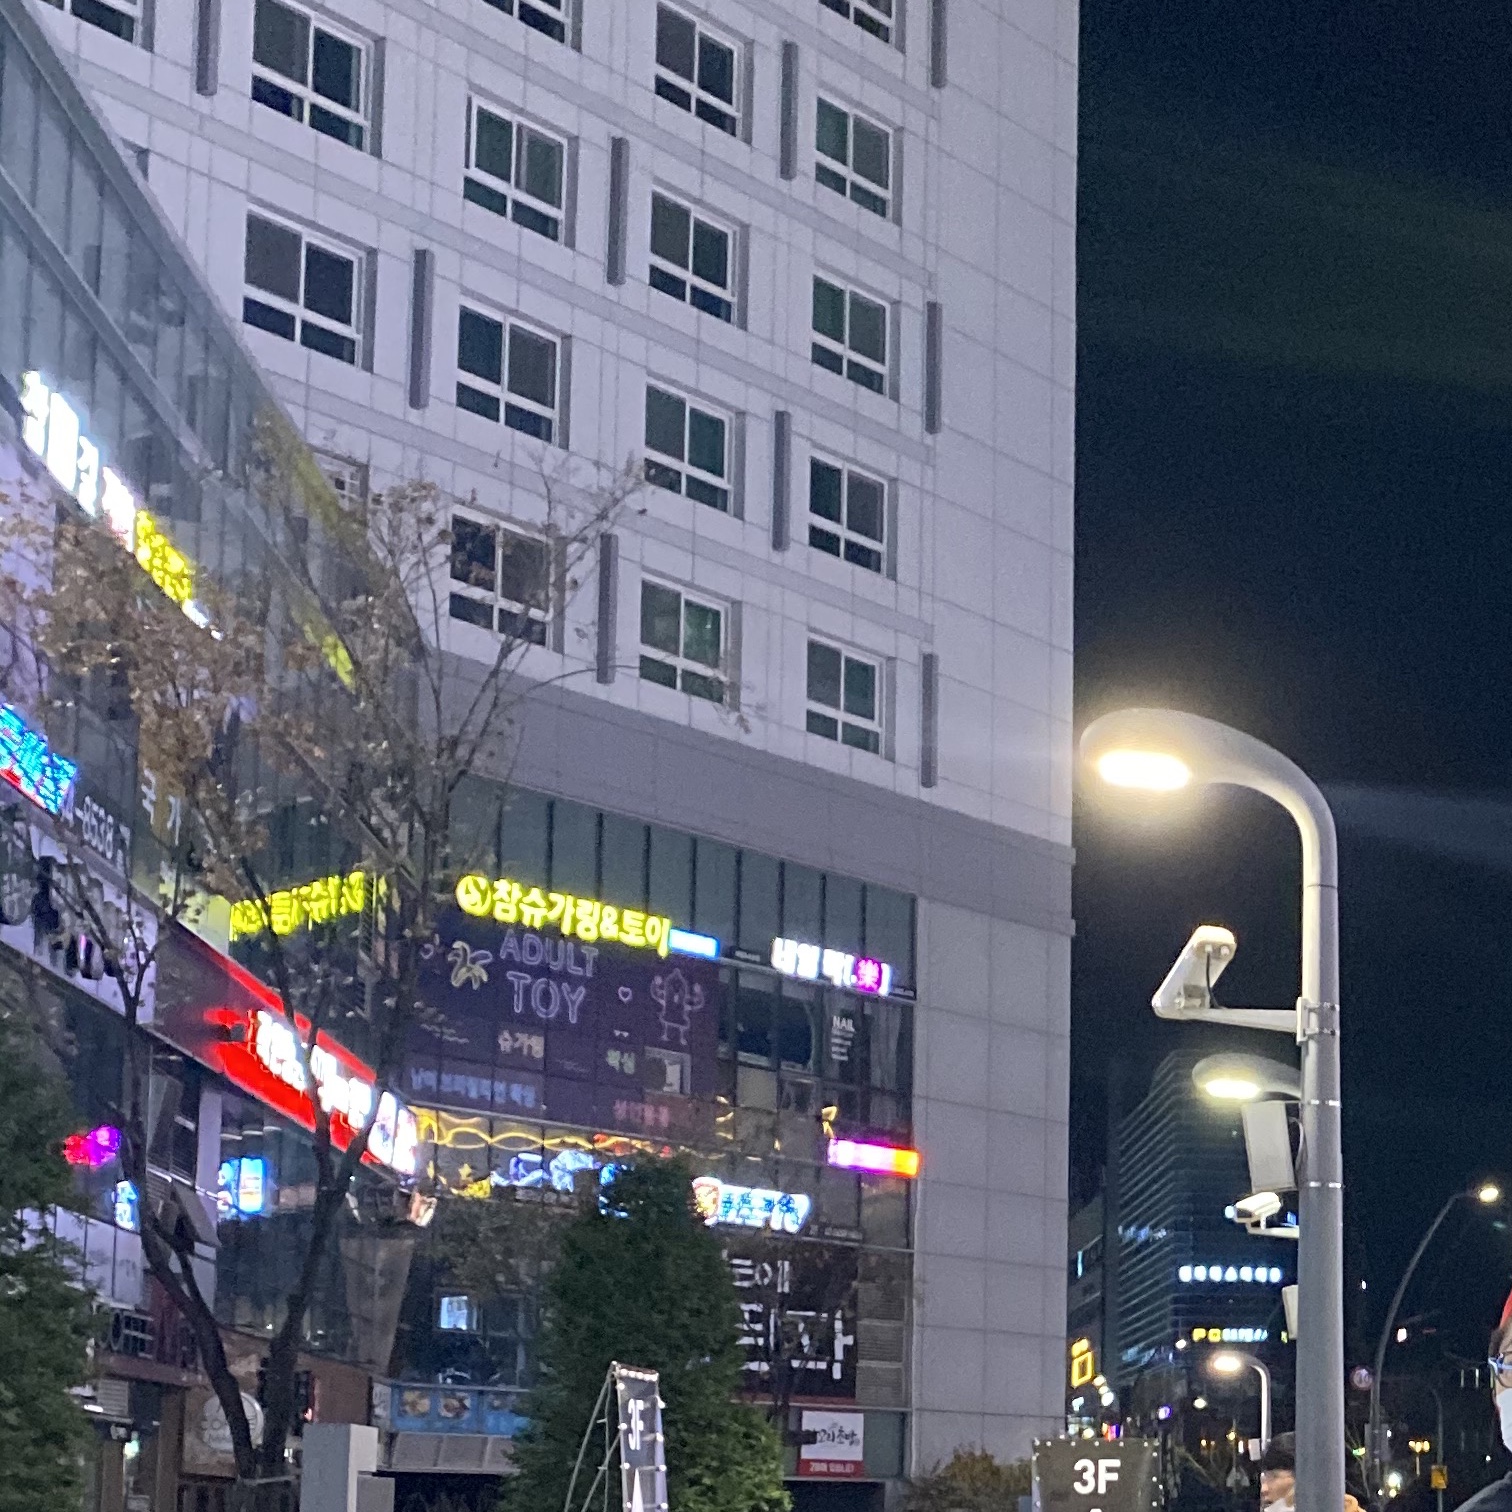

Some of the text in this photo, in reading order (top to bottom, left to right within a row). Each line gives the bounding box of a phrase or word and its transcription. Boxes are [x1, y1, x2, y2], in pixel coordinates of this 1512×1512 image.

[492, 878, 673, 959] 참슈가링&토이
[500, 929, 599, 978] ADULT
[506, 970, 586, 1024] TOY
[628, 1397, 645, 1452] 3F
[1072, 1458, 1122, 1495] 3F
